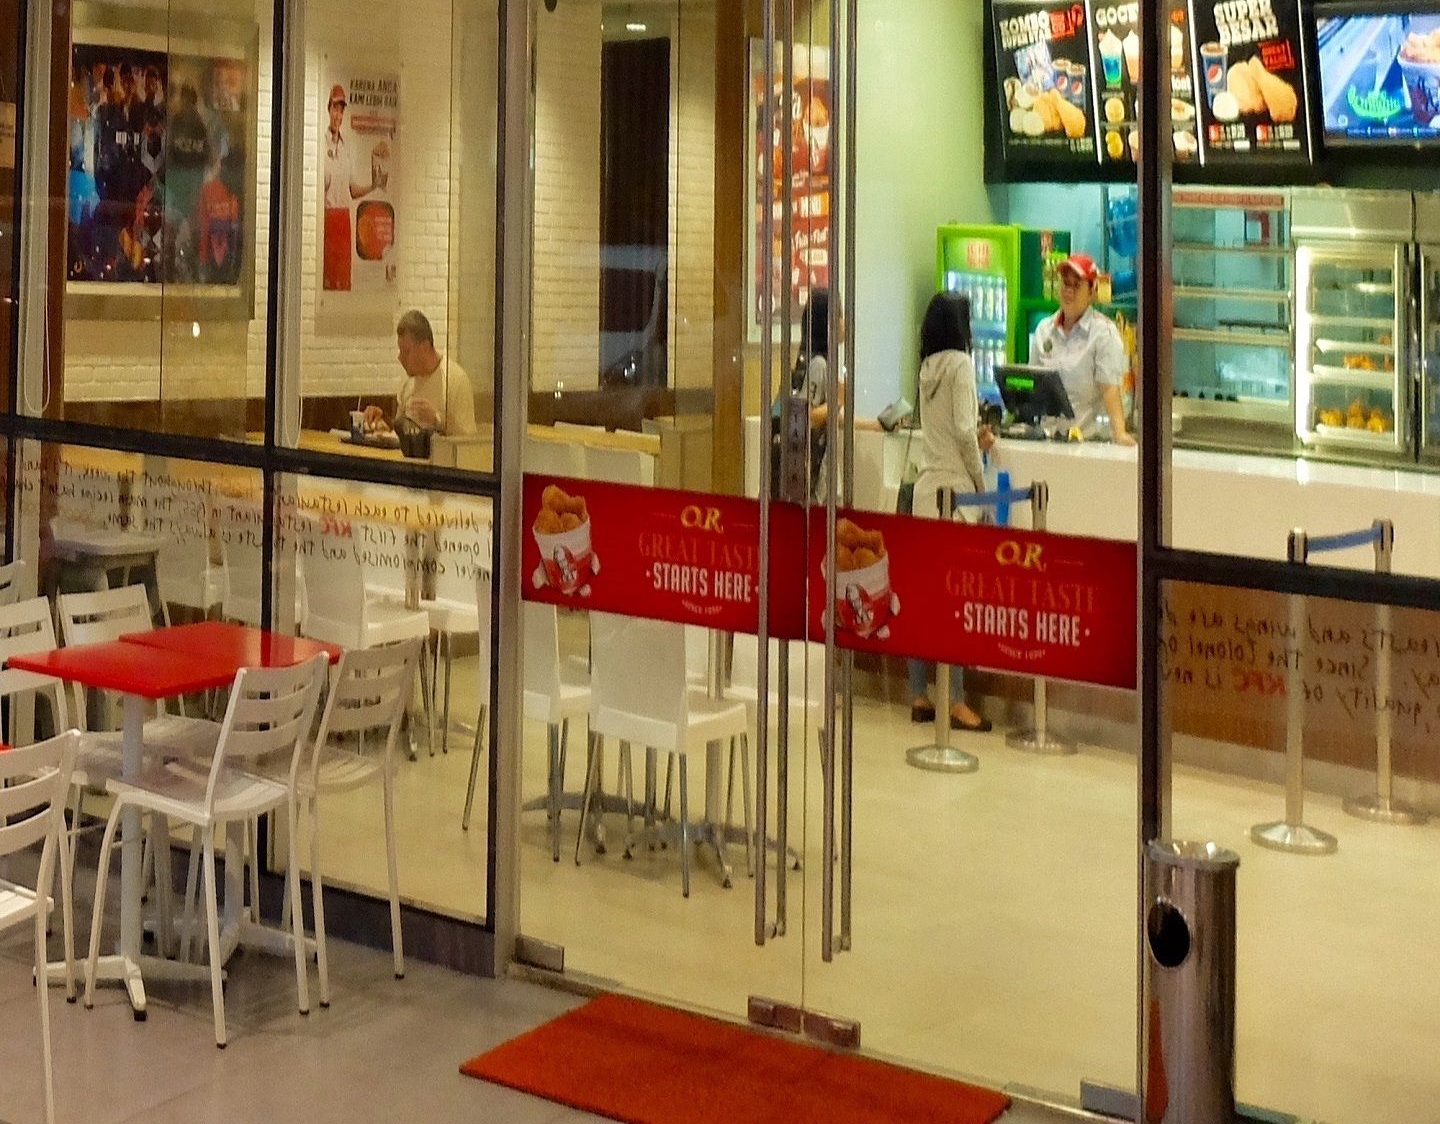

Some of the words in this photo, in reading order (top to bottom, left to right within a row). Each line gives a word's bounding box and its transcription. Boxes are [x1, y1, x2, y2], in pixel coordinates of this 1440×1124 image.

[638, 532, 699, 564] GREAT
[653, 562, 708, 597] STARTS
[714, 571, 752, 603] HERE
[945, 569, 1016, 603] GREAT
[1031, 578, 1100, 613] TASTE
[964, 601, 1029, 640] STARTS
[1035, 612, 1081, 647] HERE
